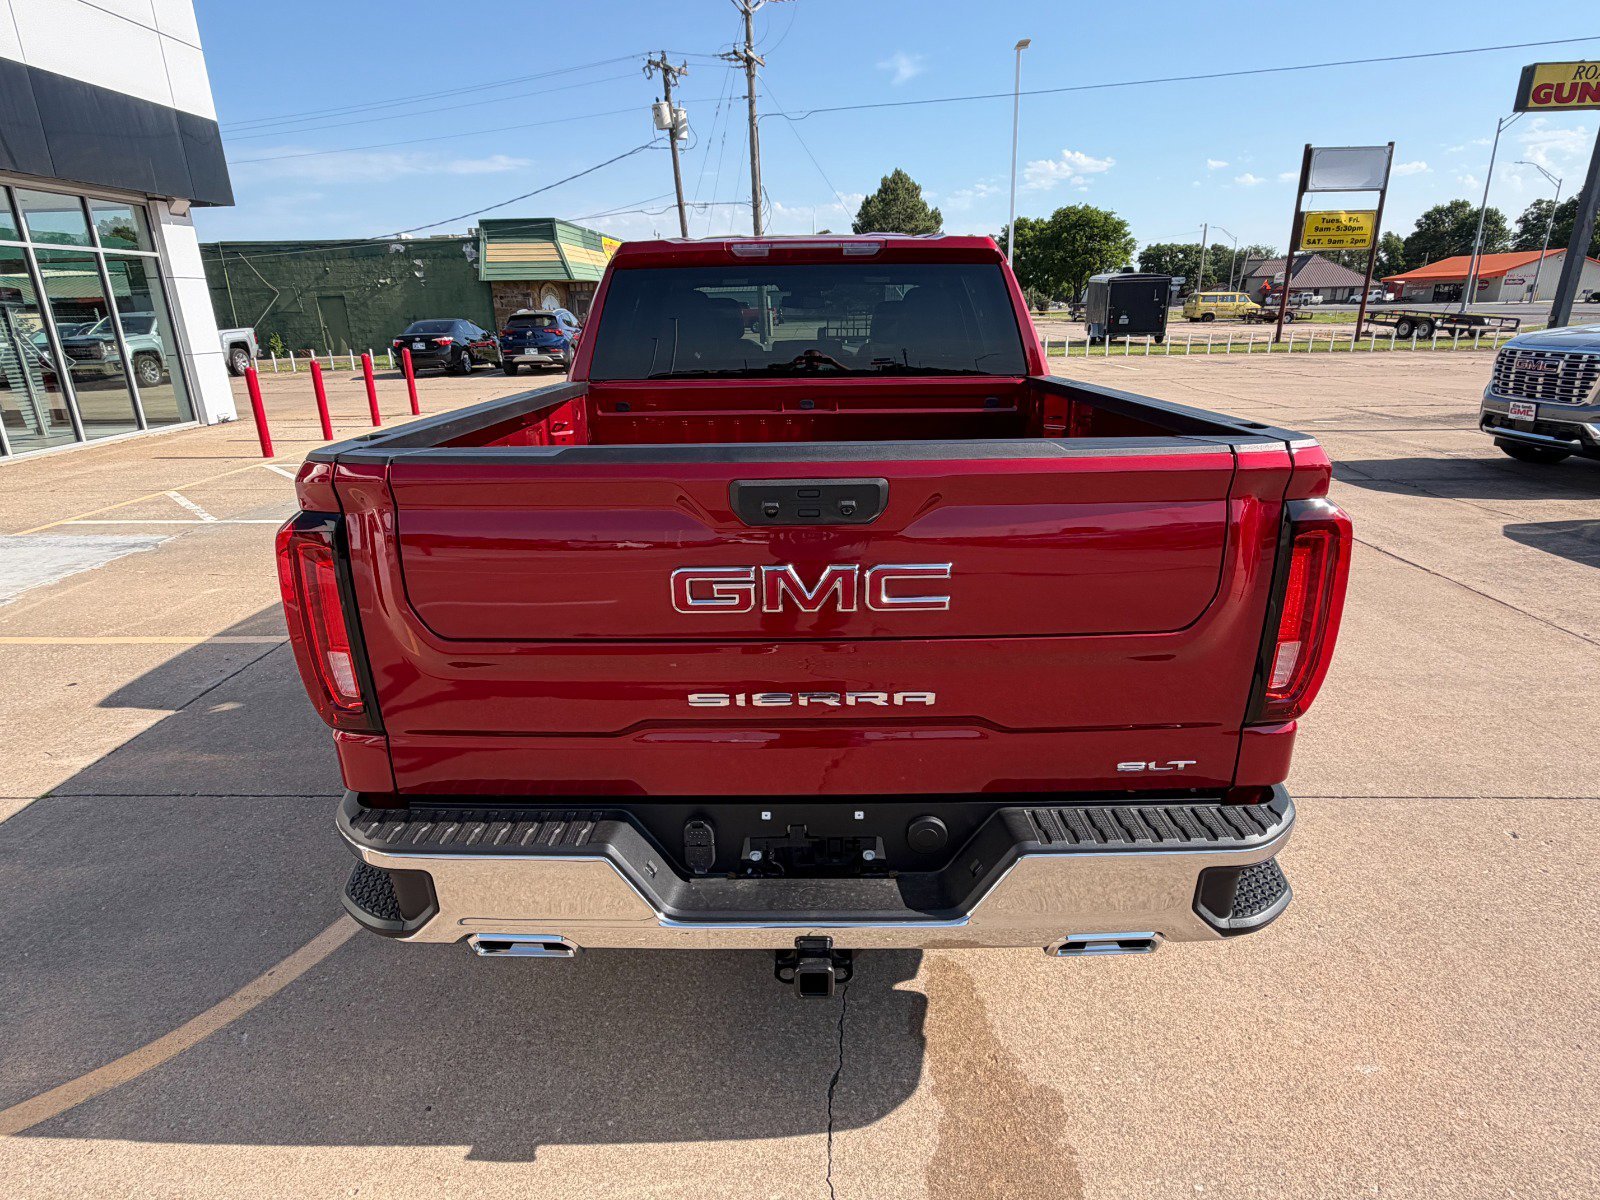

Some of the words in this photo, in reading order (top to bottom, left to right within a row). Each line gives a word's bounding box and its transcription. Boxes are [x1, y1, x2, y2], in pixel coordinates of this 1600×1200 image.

[1306, 238, 1324, 246] SAT.
[1327, 238, 1344, 246] 9am
[1350, 237, 1367, 246] 2pm
[1515, 359, 1559, 371] GMC
[1509, 408, 1535, 417] GMC
[670, 562, 953, 615] GMC
[687, 691, 937, 708] SIERRA
[1116, 760, 1198, 772] SLT
